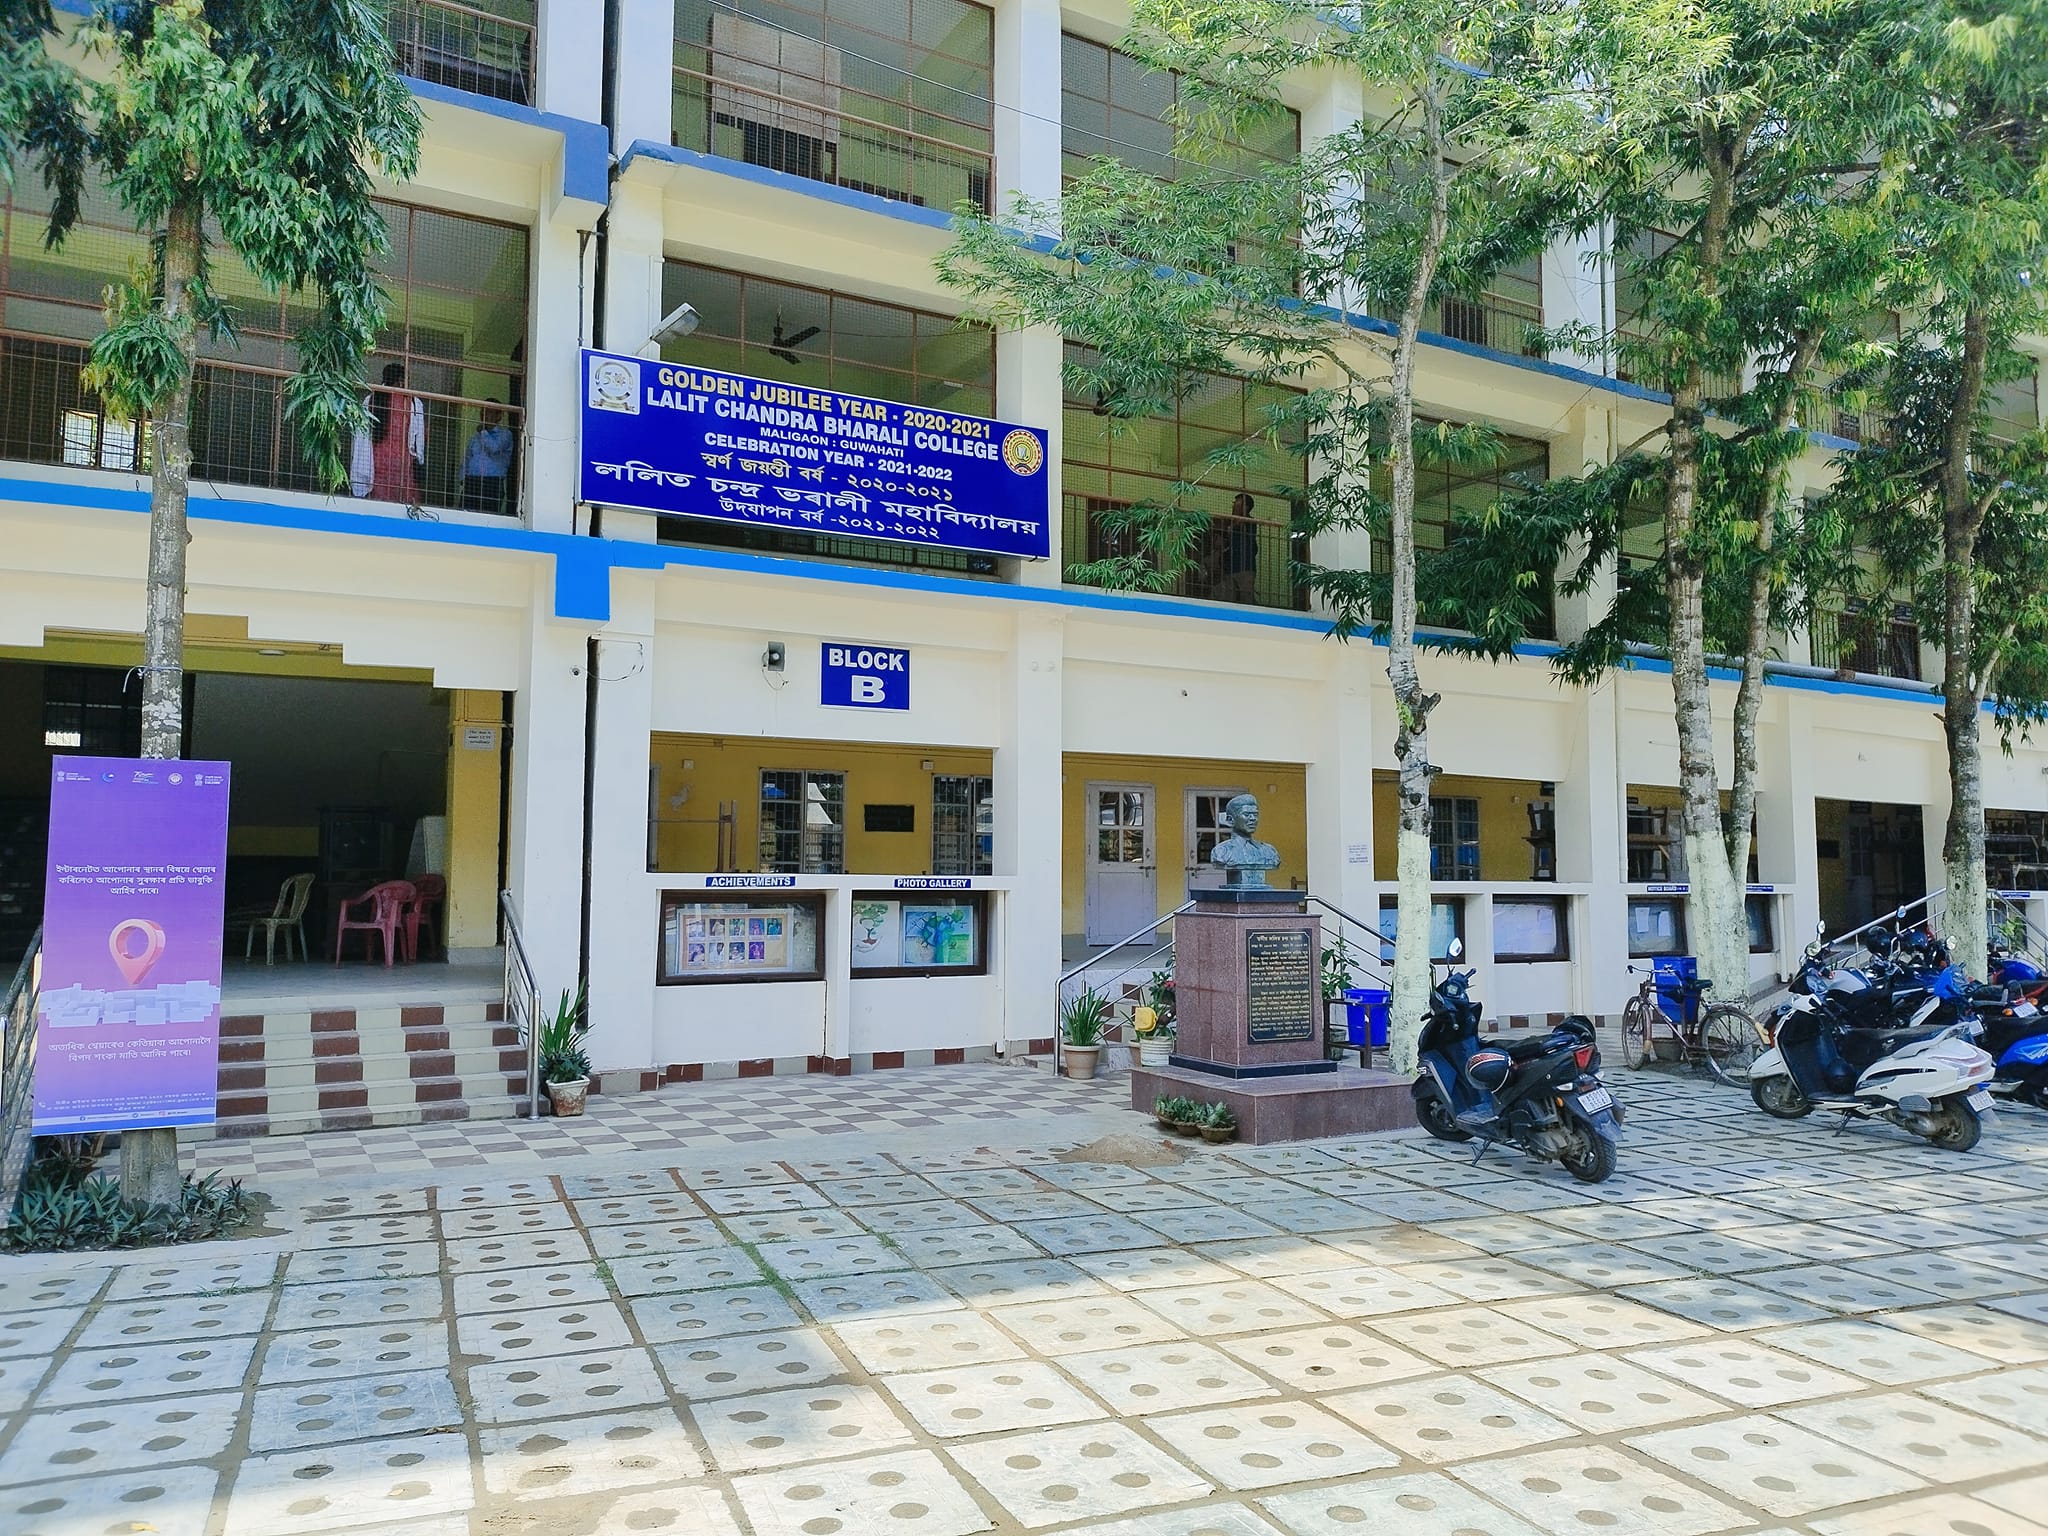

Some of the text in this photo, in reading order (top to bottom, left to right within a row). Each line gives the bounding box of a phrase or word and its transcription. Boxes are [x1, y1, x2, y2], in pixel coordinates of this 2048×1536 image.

[658, 367, 744, 398] GOLDEN
[750, 384, 831, 413] JUBILEE
[838, 398, 887, 421] YEAR
[903, 410, 990, 439] 2020-2021
[647, 387, 709, 414] LALIT
[714, 399, 818, 432] CHANDRA
[824, 416, 908, 447] BHARALI
[914, 432, 999, 460] COLLEGE
[704, 432, 819, 461] CELEBRATION
[823, 450, 865, 468] YEAR
[877, 459, 953, 481] 2021-2022
[760, 427, 828, 447] MALIGAON
[840, 439, 904, 458] GUWAHATI
[590, 460, 696, 488] ললিত
[847, 474, 953, 501] ২০২০-২০২১
[829, 648, 904, 672] BLOCK
[851, 674, 886, 703] B
[711, 877, 791, 887] ACHIEVEMENTS
[897, 879, 967, 888] PHOTO GALLERY
